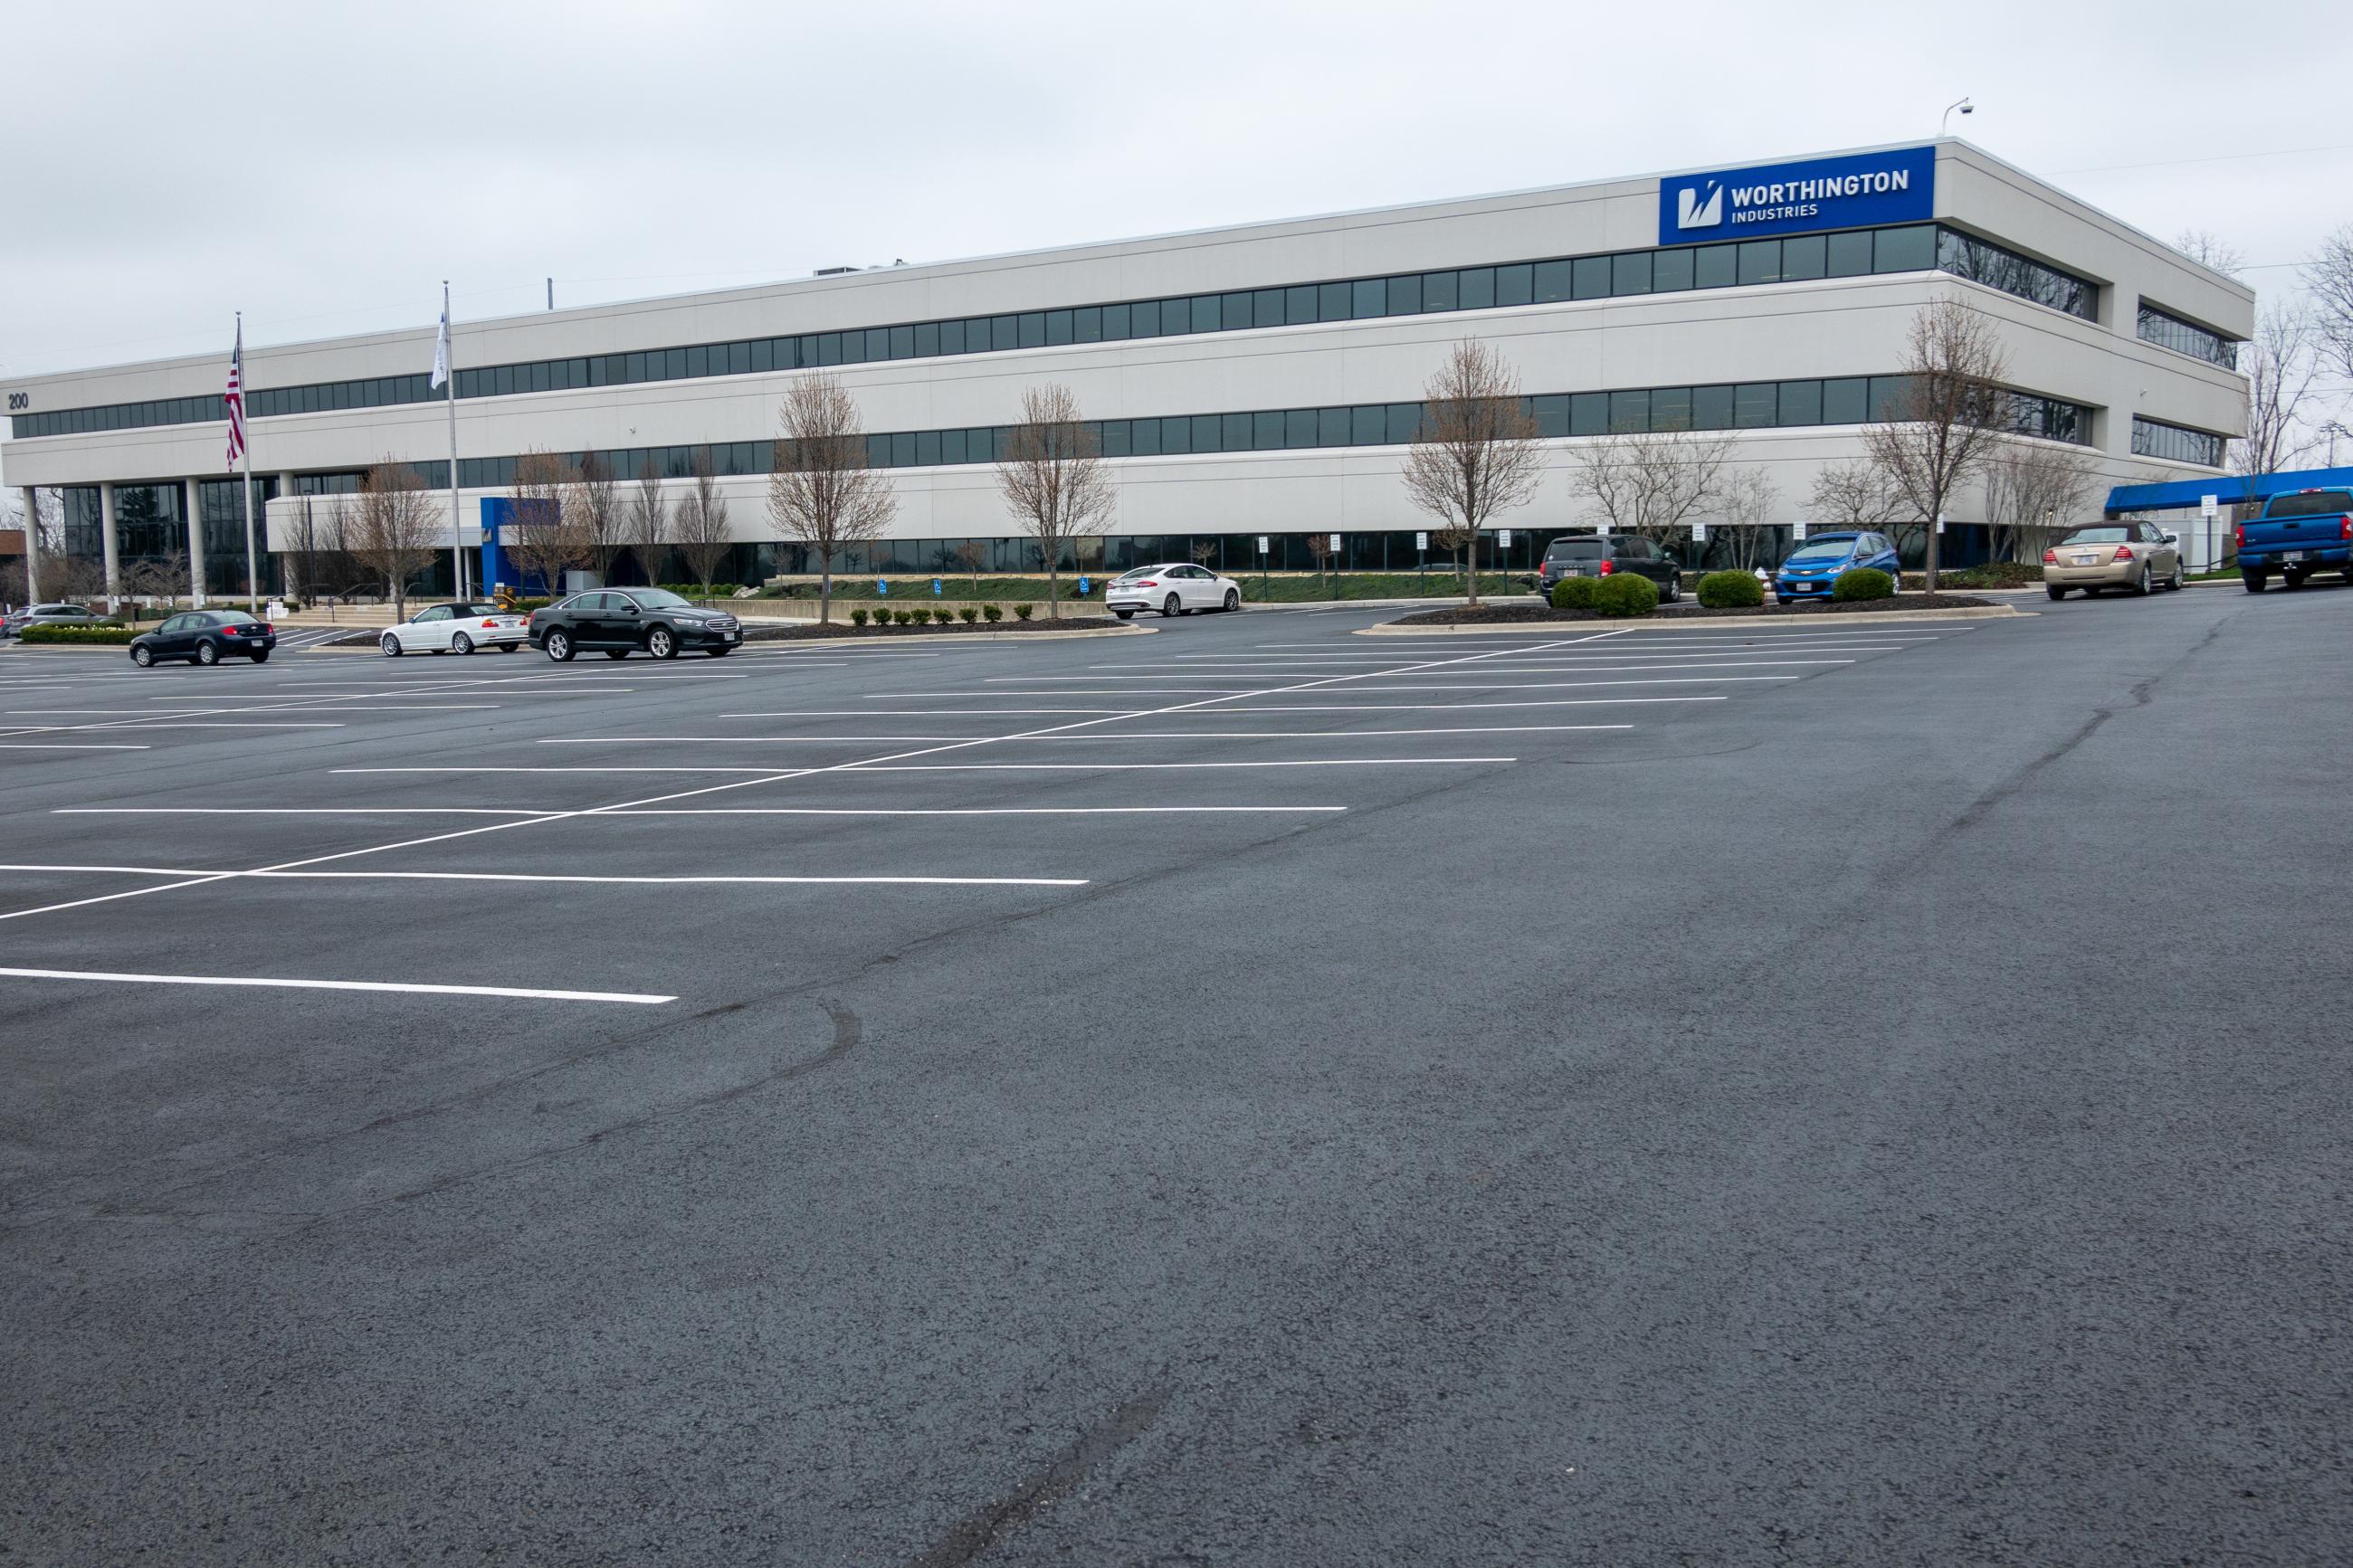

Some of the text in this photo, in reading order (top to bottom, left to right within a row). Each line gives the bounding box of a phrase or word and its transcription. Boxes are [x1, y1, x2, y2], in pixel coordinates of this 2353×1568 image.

[1731, 169, 1910, 208] WORTHINGTON
[1731, 204, 1818, 224] INDUSTRIES
[8, 392, 29, 410] 200
